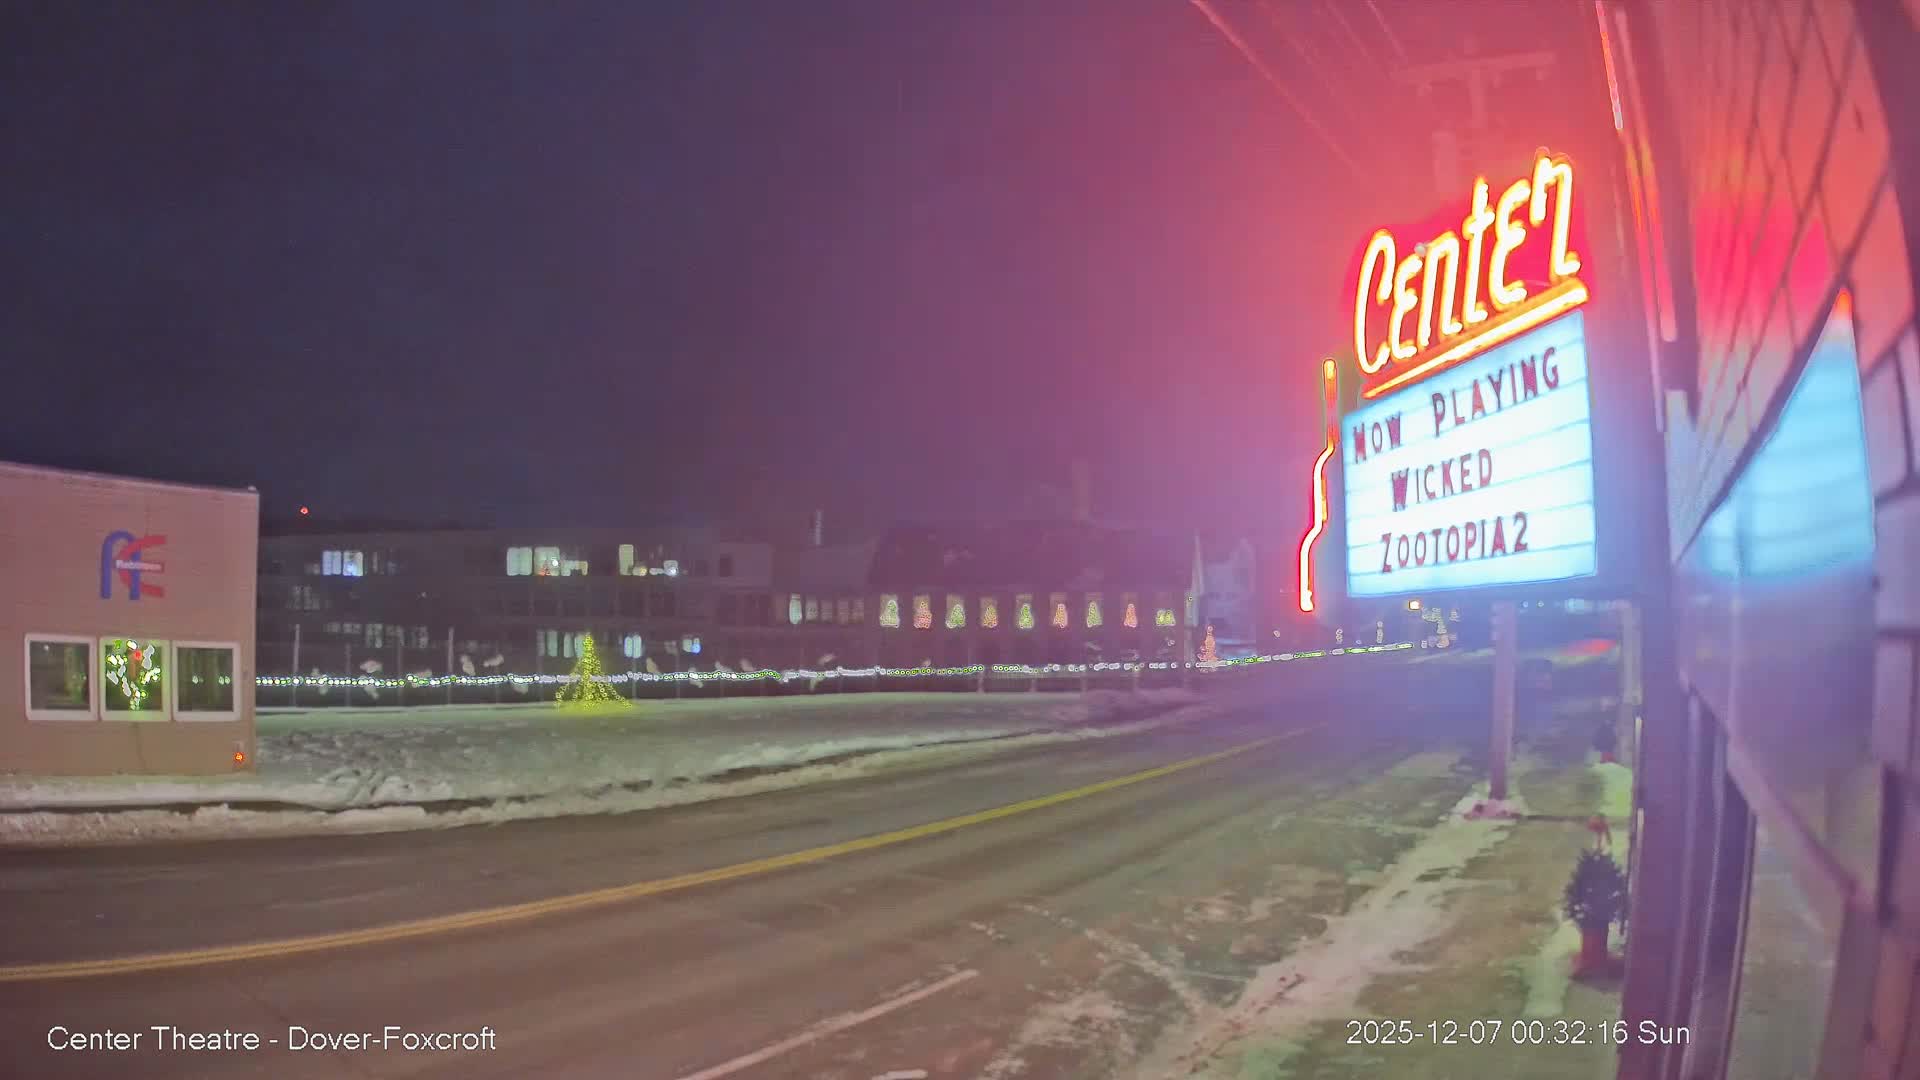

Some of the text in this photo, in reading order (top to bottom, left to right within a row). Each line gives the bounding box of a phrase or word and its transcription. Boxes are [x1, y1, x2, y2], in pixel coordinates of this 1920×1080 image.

[1353, 346, 1560, 463] NOW PLAYING
[1391, 448, 1493, 512] WICKED
